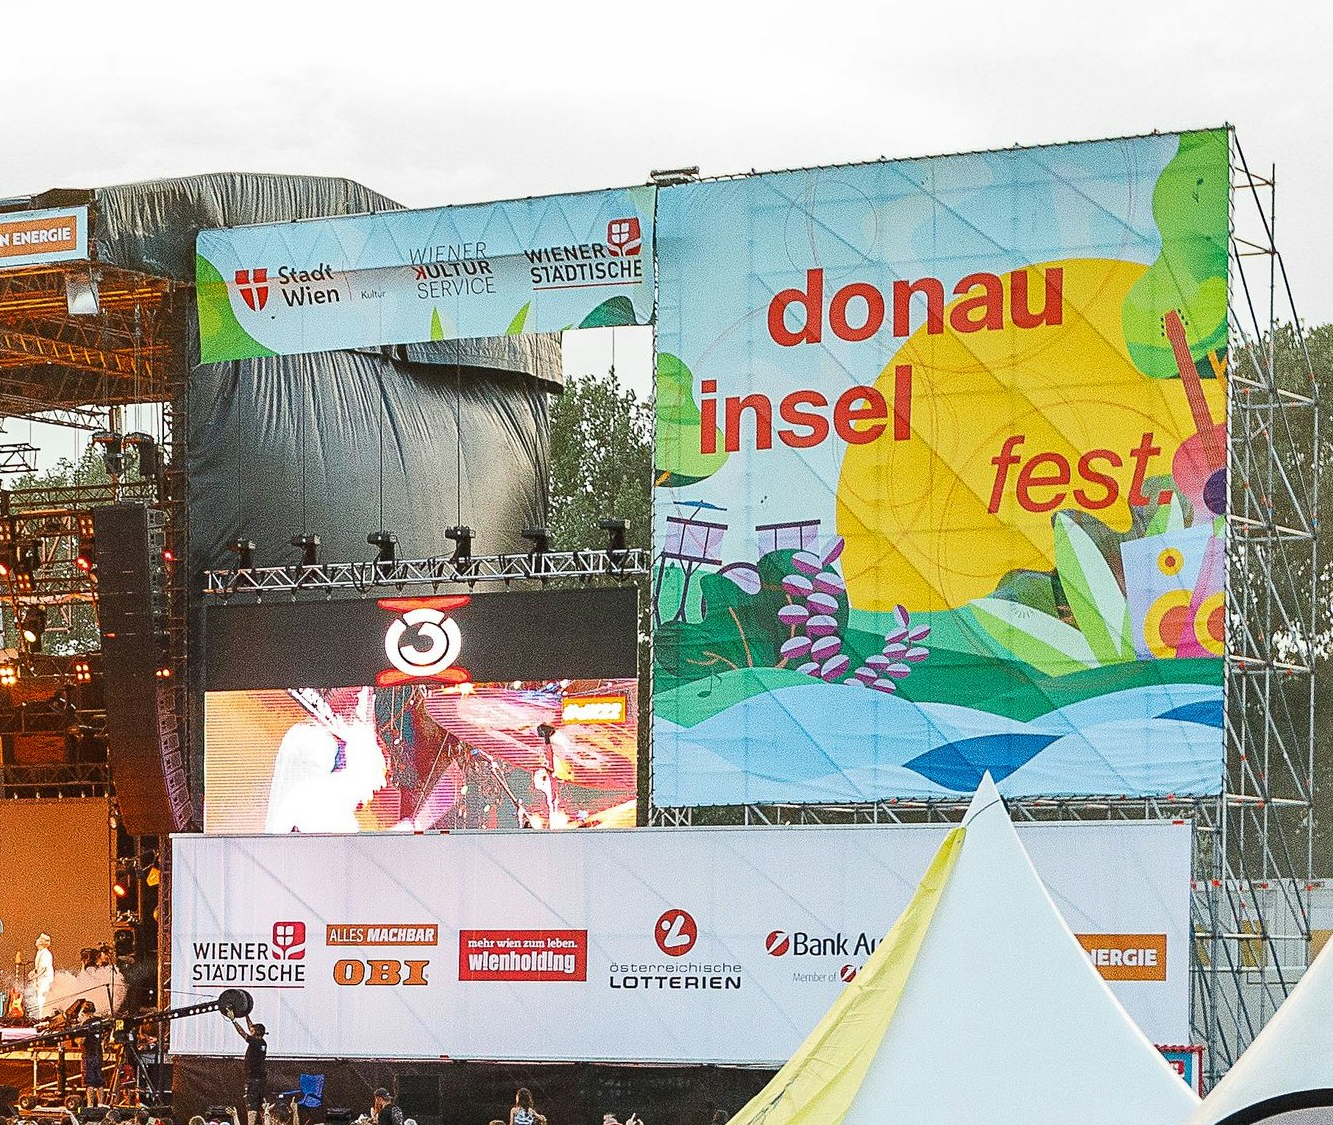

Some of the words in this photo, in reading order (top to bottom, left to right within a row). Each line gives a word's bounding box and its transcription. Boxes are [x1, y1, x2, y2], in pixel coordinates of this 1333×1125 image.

[13, 227, 72, 247] ENERGIE
[409, 241, 487, 264] WIENER
[524, 243, 604, 264] WIENER
[279, 264, 334, 286] Stadt
[412, 260, 493, 281] KULTUR
[531, 259, 642, 285] STÄDTISCHE
[281, 285, 340, 308] Wien
[361, 289, 387, 300] Kultur
[418, 277, 496, 300] SERVICE
[767, 267, 1063, 347] donau
[700, 364, 913, 454] insel
[987, 432, 1173, 514] fest.
[329, 927, 363, 943] ALLES
[366, 927, 435, 943] MACHBAR
[468, 938, 494, 948] mehr
[496, 938, 521, 948] wien
[524, 938, 544, 948] zum
[547, 938, 578, 948] leben.
[794, 932, 848, 956] Bank
[194, 942, 269, 961] WIENER
[1088, 948, 1158, 967] NERGIE
[193, 962, 306, 982] STÄDTISCHE
[333, 959, 429, 986] OBI
[609, 962, 742, 974] österreichische
[793, 973, 826, 982] Member
[829, 973, 837, 982] of
[610, 976, 741, 990] LOTTERIEN
